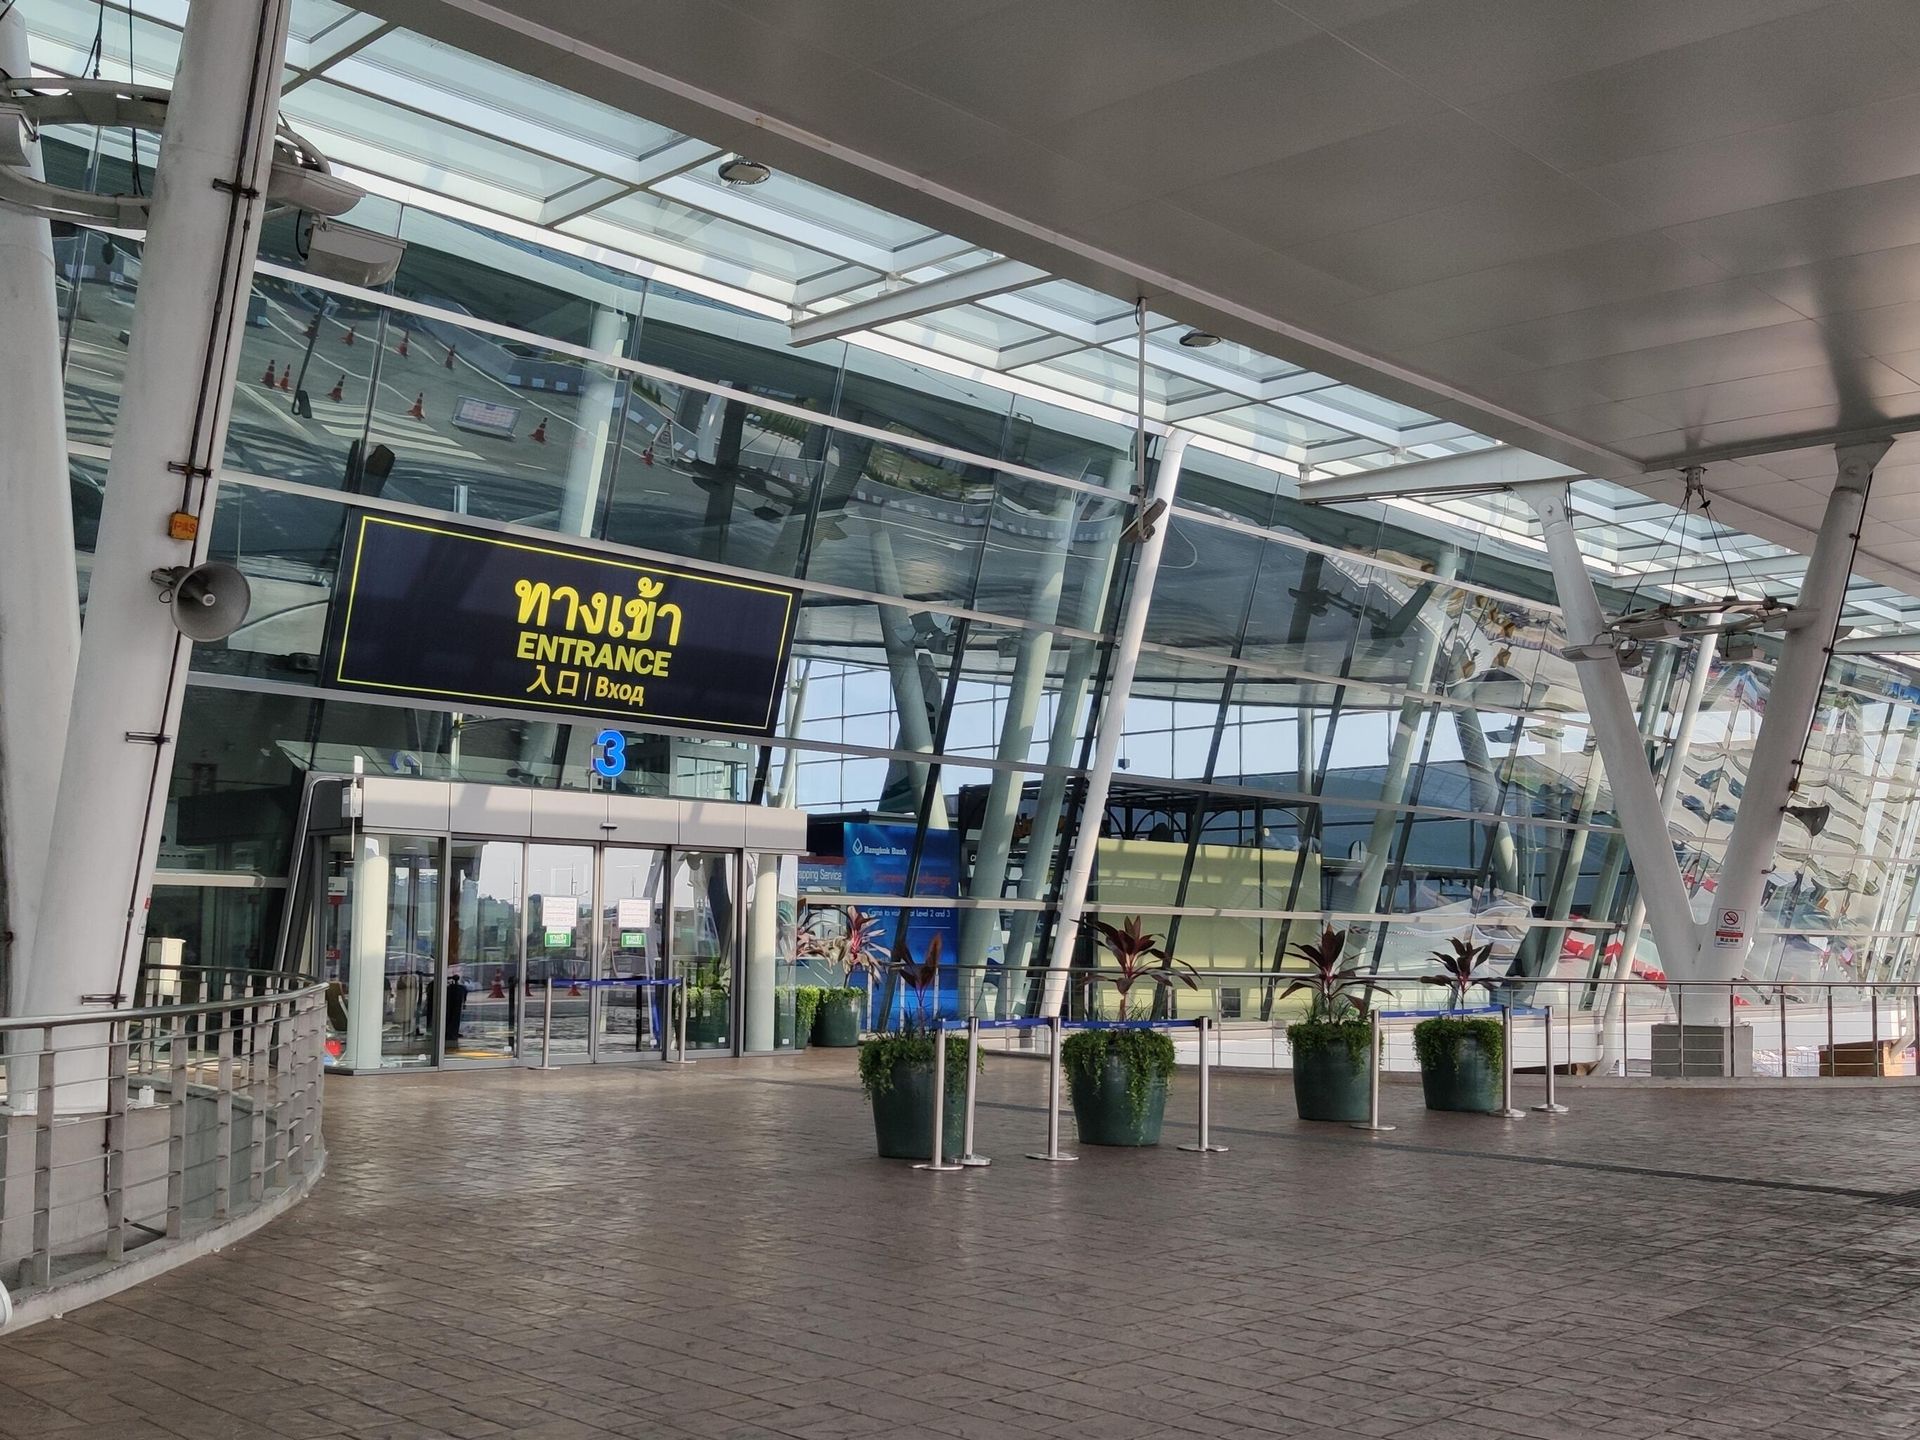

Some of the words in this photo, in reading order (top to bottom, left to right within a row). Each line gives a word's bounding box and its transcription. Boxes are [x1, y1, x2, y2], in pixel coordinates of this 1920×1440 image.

[514, 576, 683, 647] ทางเข้า
[516, 631, 673, 678] ENTRANCE
[526, 664, 580, 697] 入口
[595, 676, 645, 707] Вход
[595, 729, 626, 777] 3
[891, 847, 907, 856] Bank
[819, 868, 842, 881] Service
